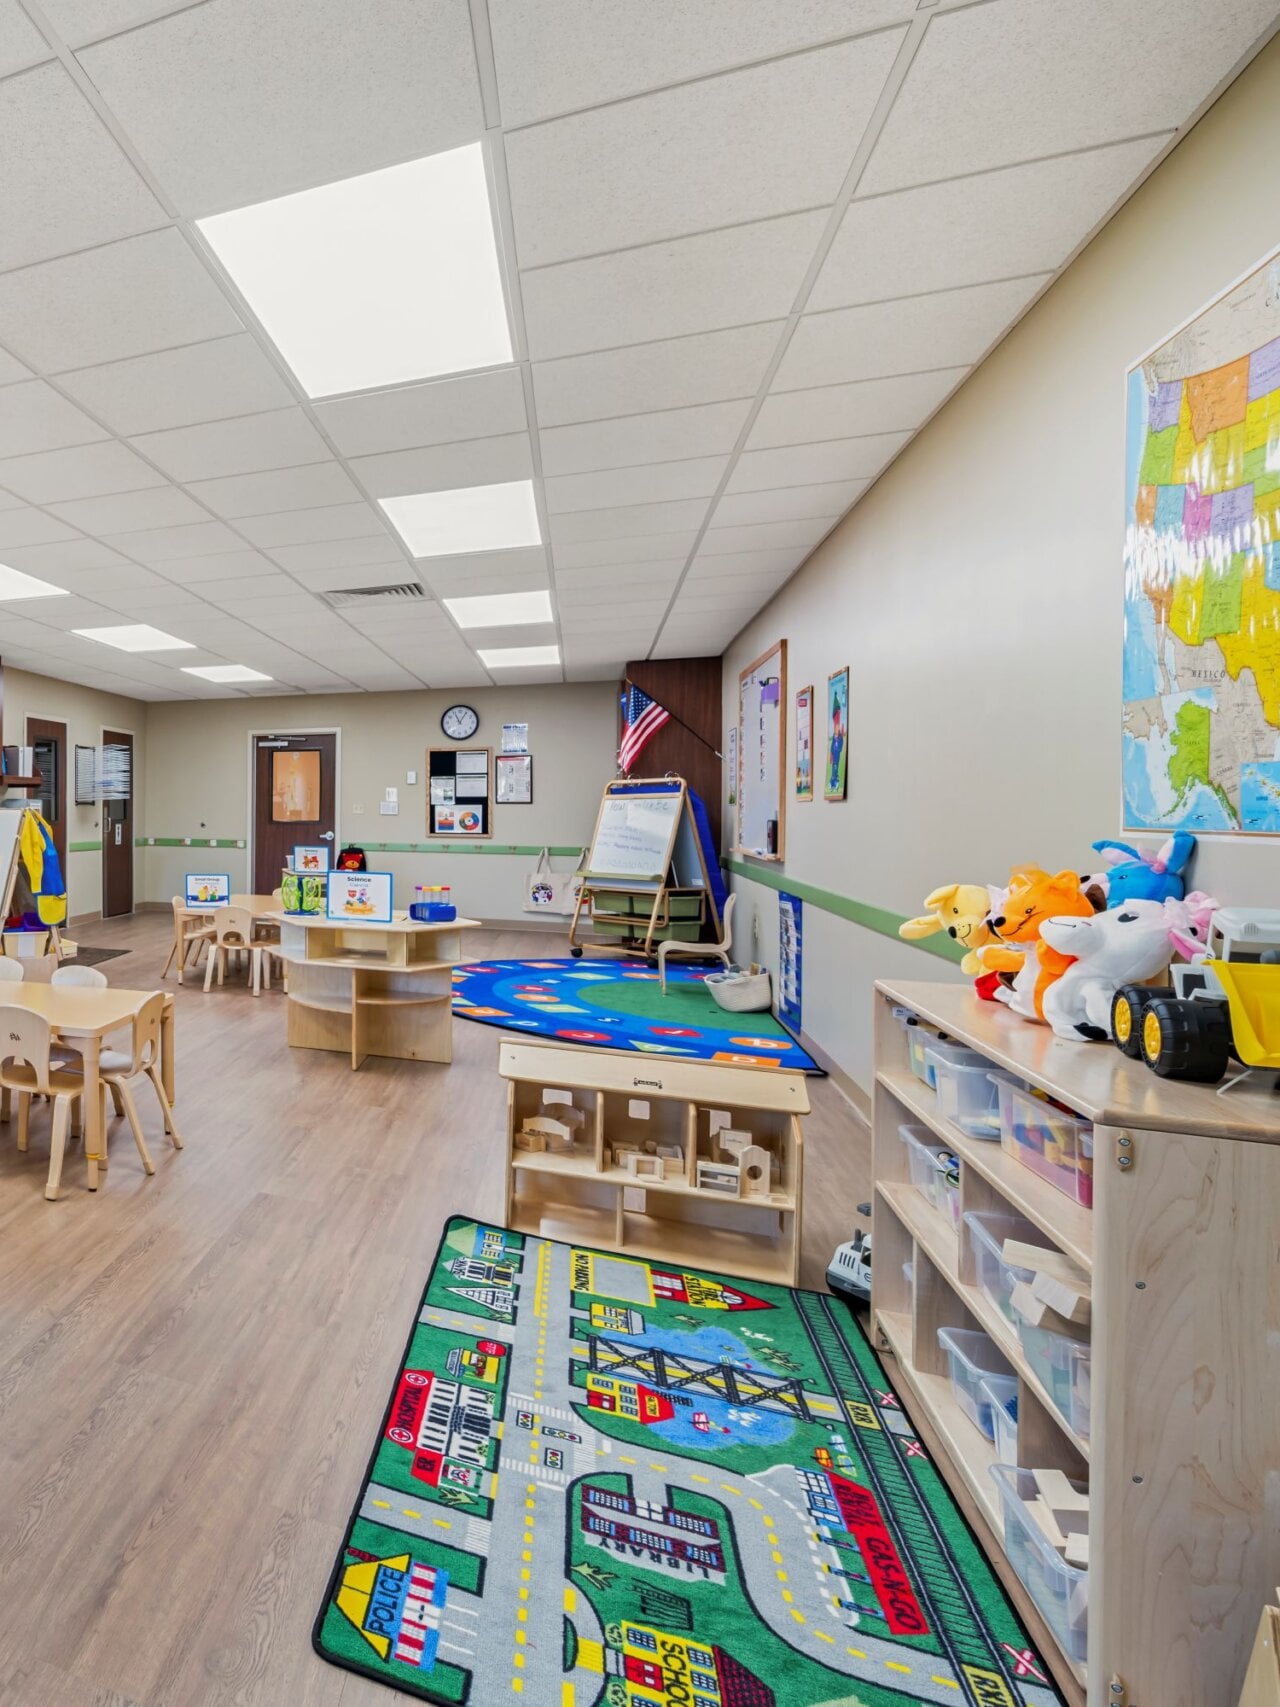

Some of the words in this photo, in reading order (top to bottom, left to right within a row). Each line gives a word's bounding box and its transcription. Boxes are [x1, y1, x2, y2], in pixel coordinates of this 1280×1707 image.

[452, 1256, 467, 1279] BANK
[574, 1253, 589, 1265] NO
[574, 1265, 589, 1291] PARKING
[685, 1276, 707, 1308] STATION
[703, 1284, 723, 1301] FIRE
[395, 1385, 423, 1431] HOSPITAL
[416, 1456, 435, 1472] ER
[598, 1537, 710, 1579] LIBRARY
[866, 1536, 922, 1631] GAS-N-GO
[368, 1568, 405, 1636] POLICE
[660, 1640, 693, 1707] SCHO
[969, 1673, 1009, 1707] RX
